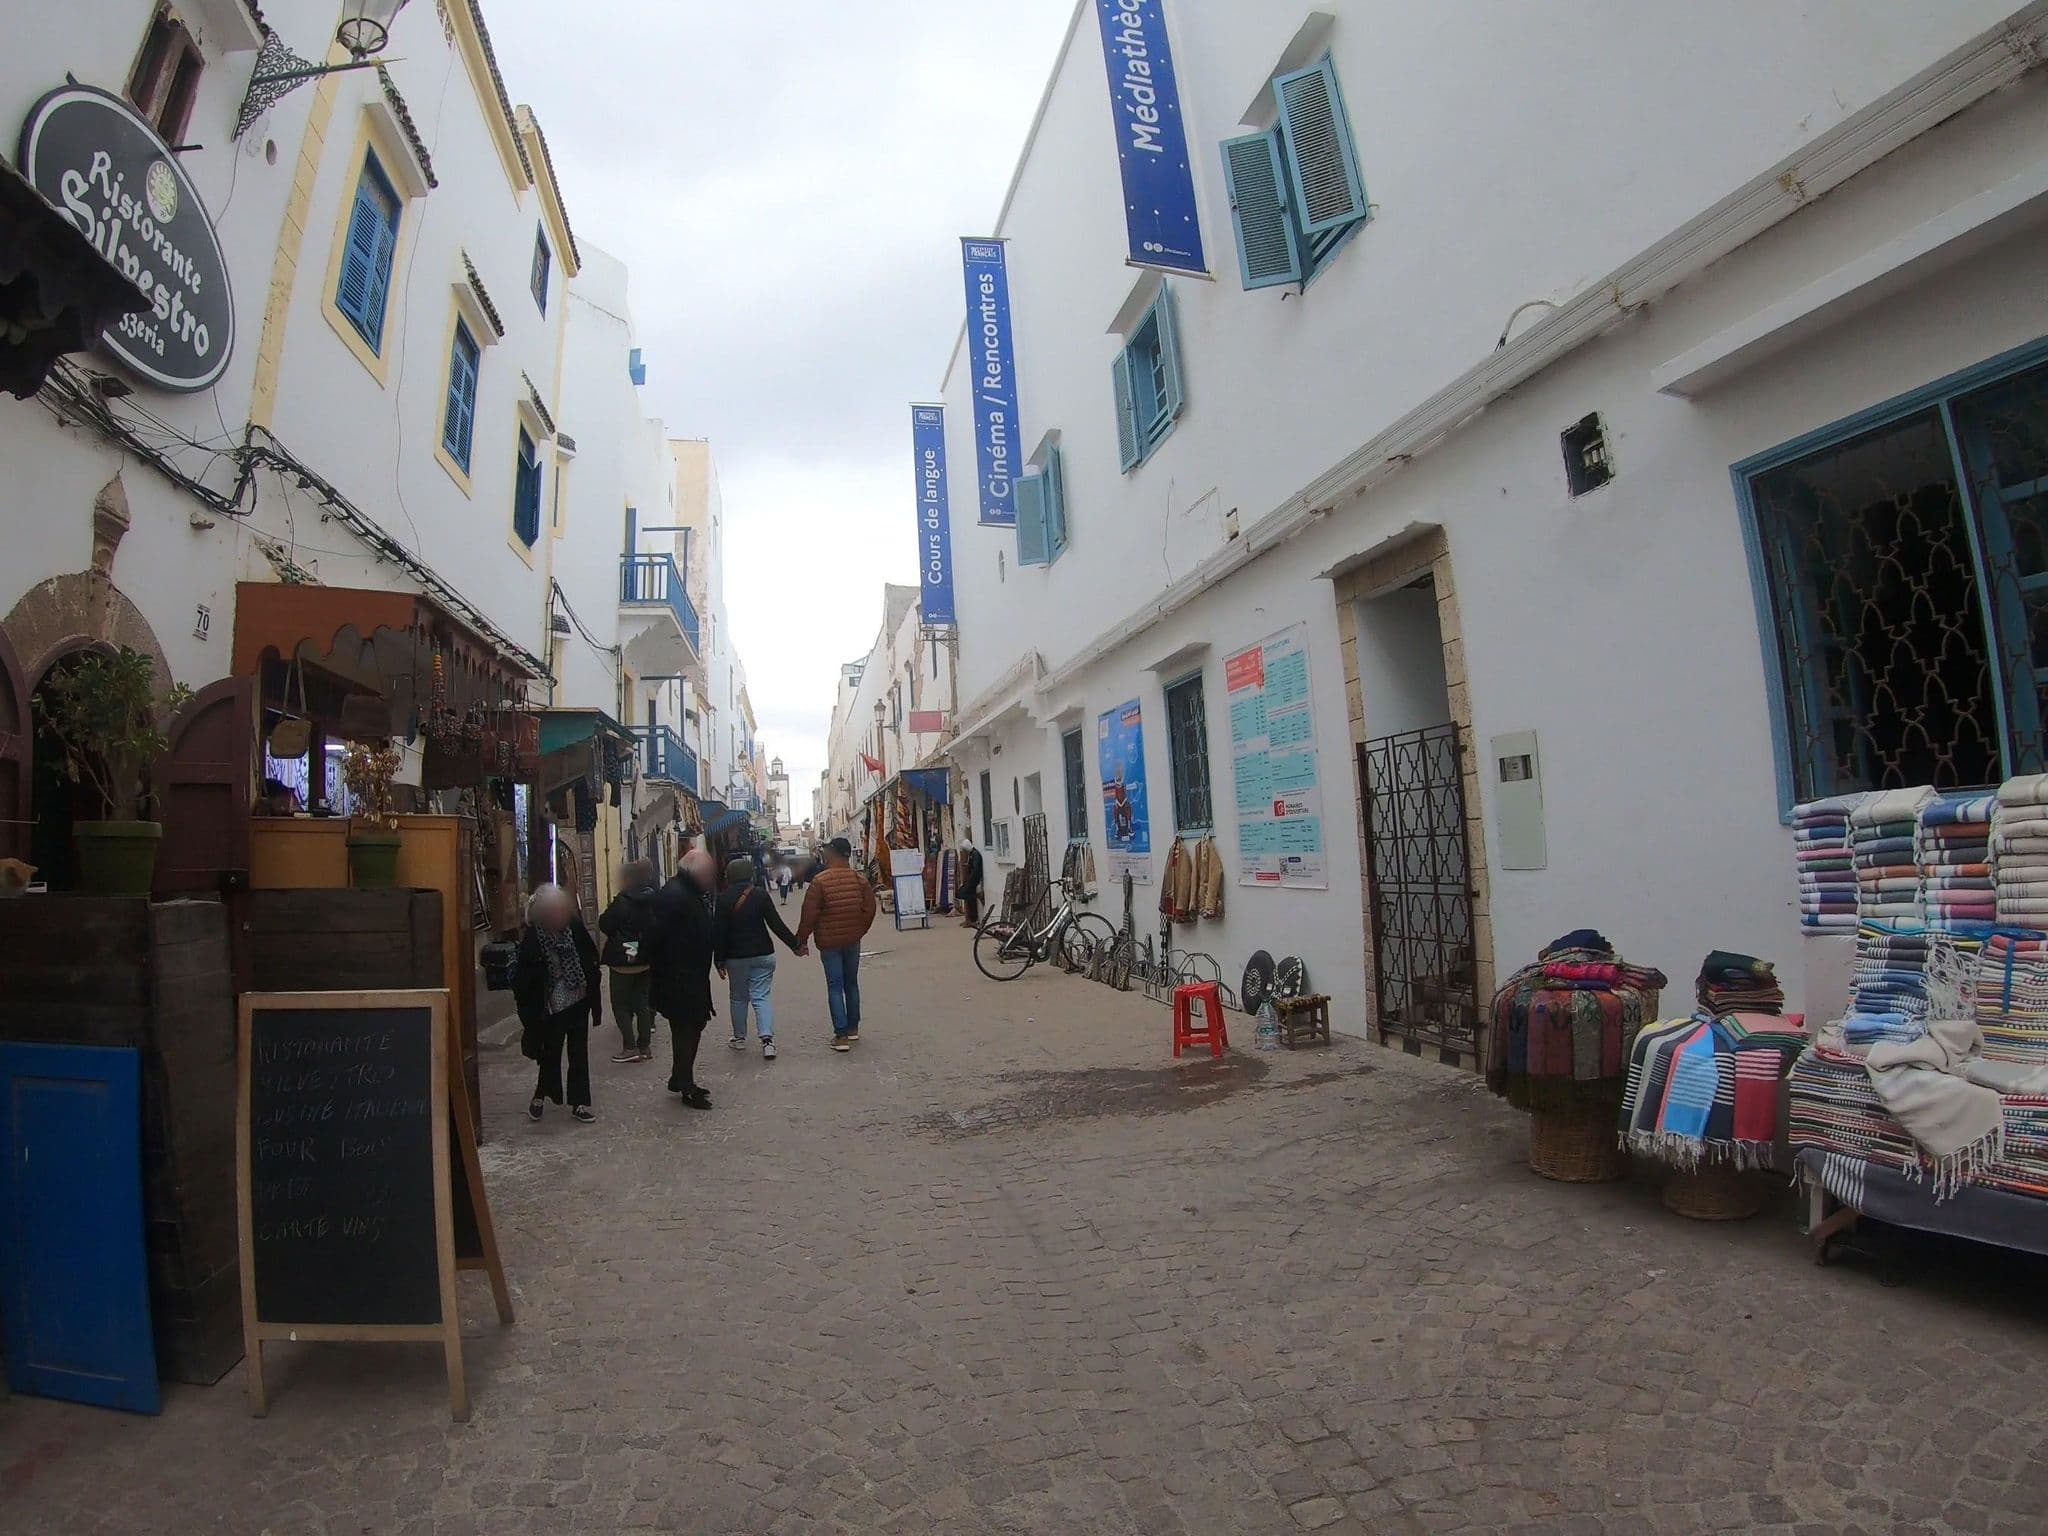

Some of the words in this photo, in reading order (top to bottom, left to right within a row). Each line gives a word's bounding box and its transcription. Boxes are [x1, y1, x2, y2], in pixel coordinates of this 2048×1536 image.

[89, 151, 201, 294] Ristorante
[979, 273, 1002, 388] Rencontres
[923, 448, 940, 502] langue
[985, 411, 1009, 497] Cinéma
[924, 509, 939, 528] de
[927, 535, 943, 585] Cours
[196, 609, 210, 632] 70
